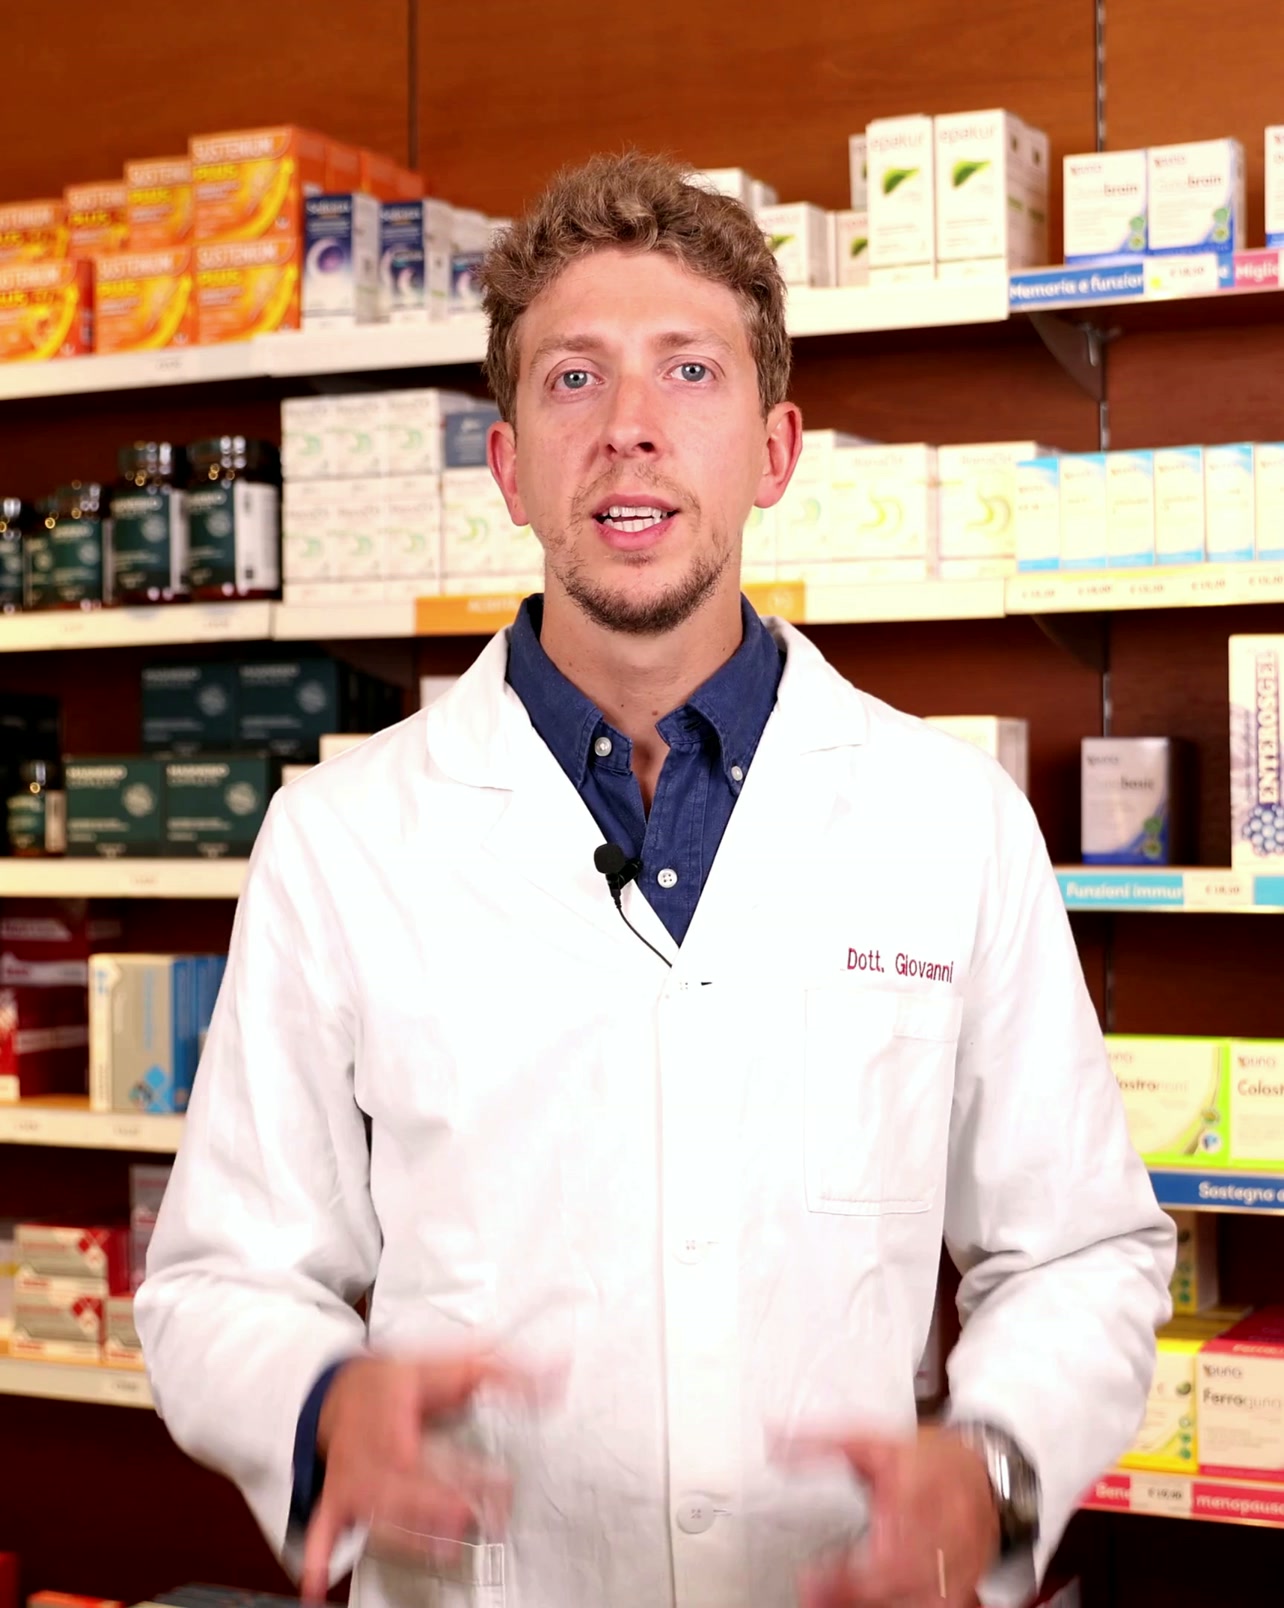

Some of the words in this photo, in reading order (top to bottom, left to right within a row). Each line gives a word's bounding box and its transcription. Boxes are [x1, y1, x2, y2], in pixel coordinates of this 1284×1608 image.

[1009, 281, 1076, 300] Memoria
[1078, 279, 1090, 295] e
[1066, 881, 1128, 900] Funzioni
[847, 947, 885, 973] Dott.
[894, 952, 955, 984] Giovanni
[1198, 1180, 1274, 1206] Sostegno
